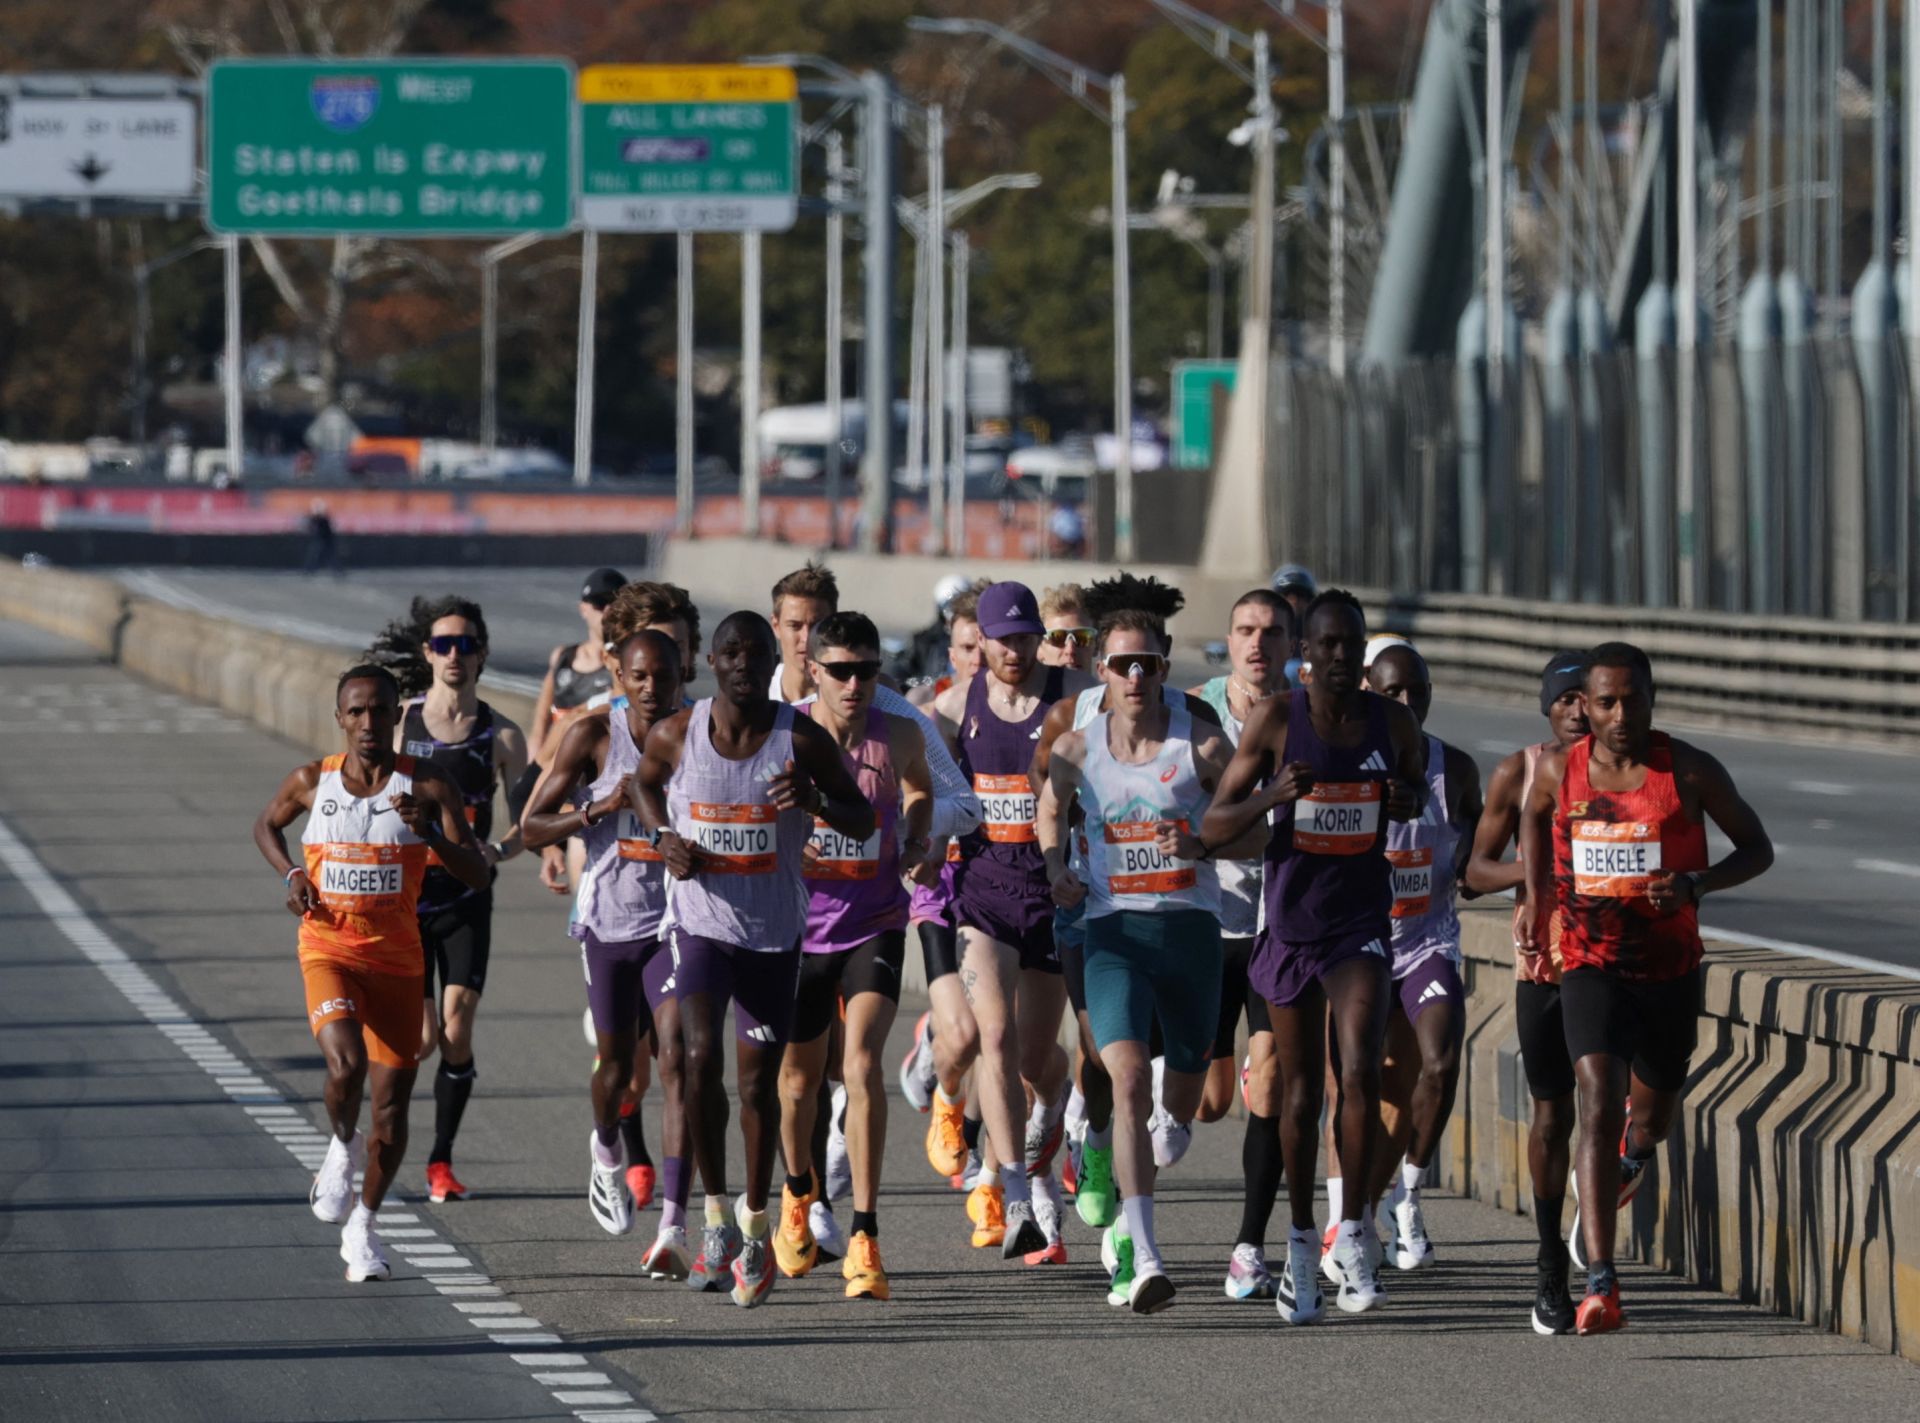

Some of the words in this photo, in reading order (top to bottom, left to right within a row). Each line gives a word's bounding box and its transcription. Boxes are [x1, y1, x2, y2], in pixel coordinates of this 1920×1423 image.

[122, 118, 179, 136] LANE
[607, 108, 662, 129] ALL
[671, 107, 768, 129] LANES
[235, 143, 360, 176] Staten
[374, 145, 407, 174] Is
[422, 143, 545, 179] Expwy
[237, 184, 403, 216] Goethals
[419, 184, 543, 221] Bridge
[1313, 808, 1362, 832] KORIR
[699, 827, 768, 852] KIPRUTO
[1126, 848, 1172, 872] BOUR
[1585, 848, 1646, 873] BEKELE
[326, 868, 397, 891] NAGEEYE
